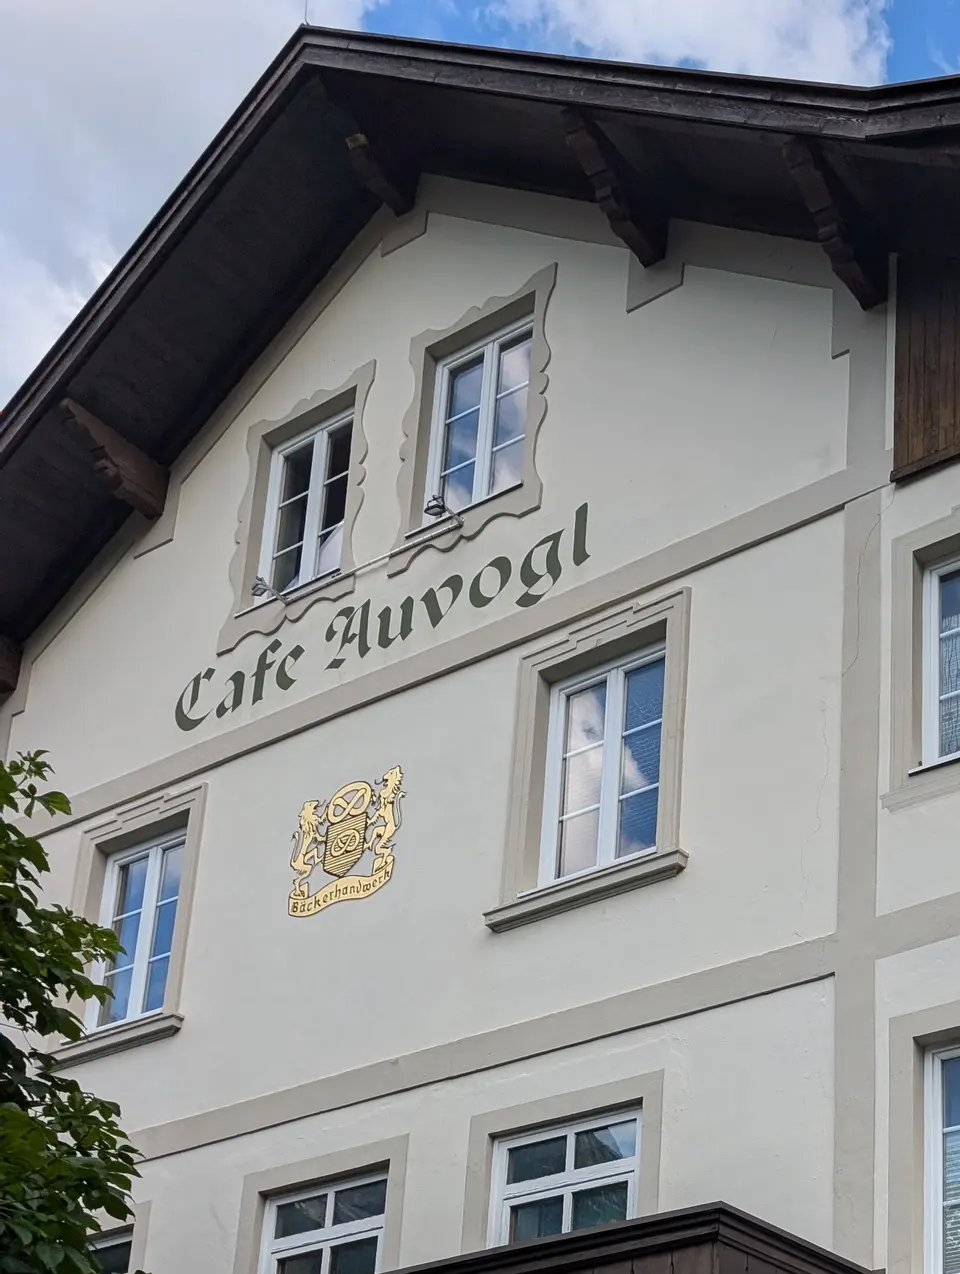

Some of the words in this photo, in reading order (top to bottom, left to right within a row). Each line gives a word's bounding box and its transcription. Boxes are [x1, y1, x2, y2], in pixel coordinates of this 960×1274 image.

[174, 637, 306, 732] Cafe
[325, 502, 592, 670] Auvogl
[291, 869, 390, 913] Bäckerhandwerk
